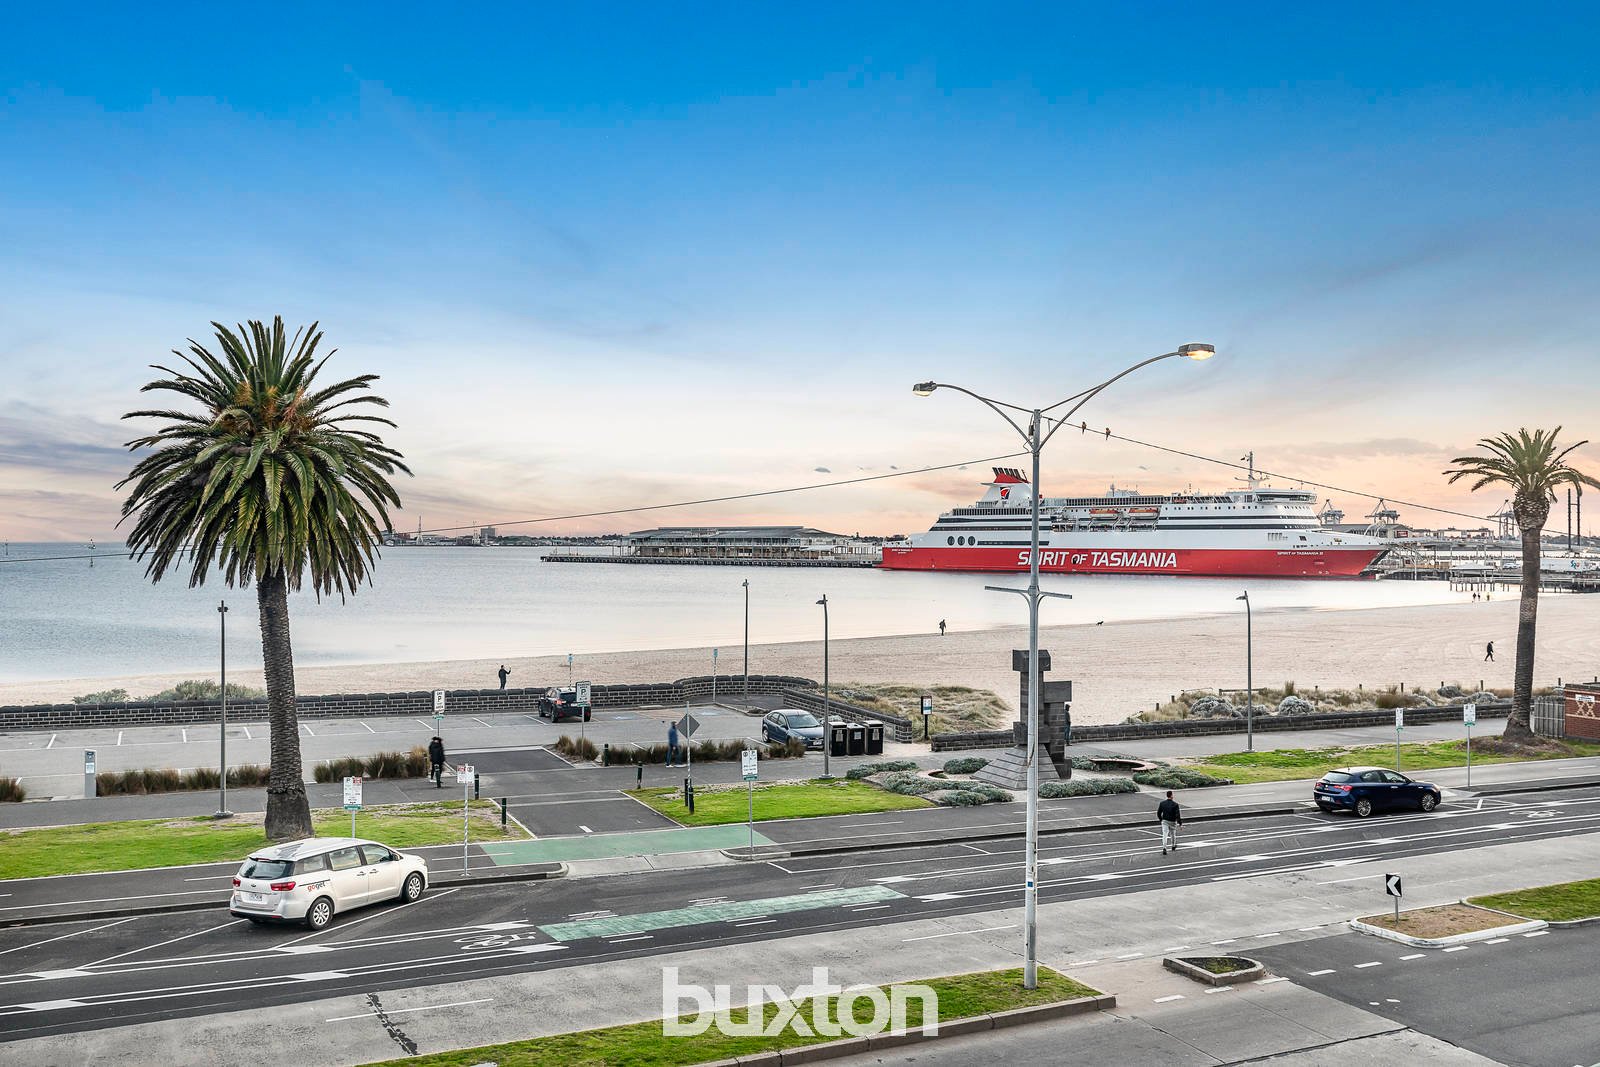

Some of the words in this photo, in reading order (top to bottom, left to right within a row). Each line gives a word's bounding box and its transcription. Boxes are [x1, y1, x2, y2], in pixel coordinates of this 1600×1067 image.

[1017, 551, 1069, 566] SIRIT
[1071, 553, 1088, 565] OF
[1091, 552, 1178, 568] TASMANIA
[581, 688, 587, 696] P
[437, 695, 442, 703] P
[308, 882, 326, 892] goget
